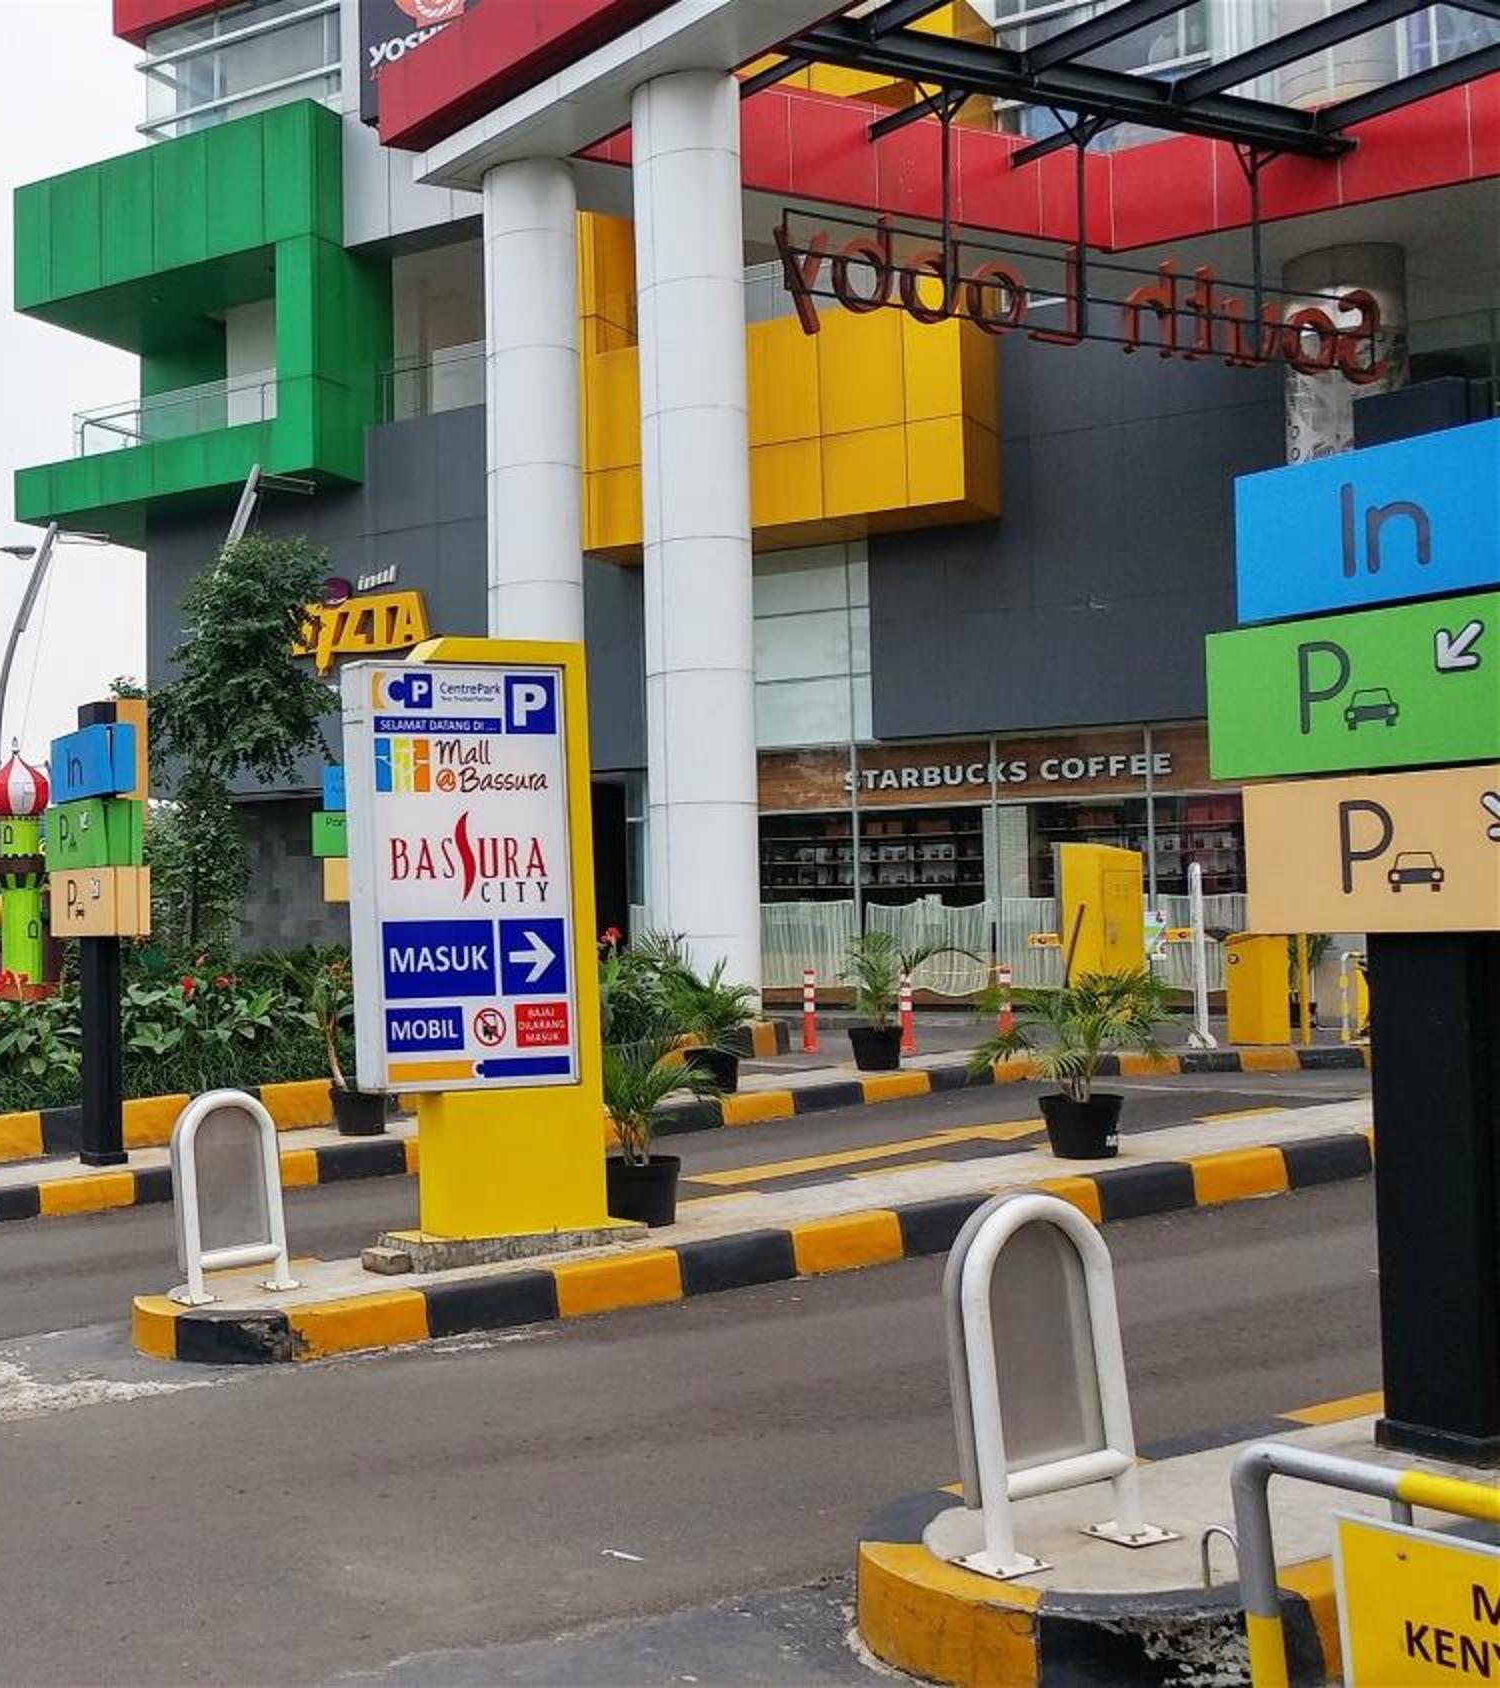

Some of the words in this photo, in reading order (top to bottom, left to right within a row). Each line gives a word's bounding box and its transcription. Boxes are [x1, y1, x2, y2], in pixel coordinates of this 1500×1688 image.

[1341, 483, 1431, 578] In
[357, 565, 397, 591] inul
[439, 681, 501, 695] CentrePark
[1298, 641, 1351, 735] P
[512, 684, 548, 727] P
[379, 719, 427, 731] SELAMAT
[429, 720, 470, 731] DATANG
[435, 739, 492, 765] Mall
[67, 751, 84, 789] In
[843, 761, 1028, 791] STARBUCKS
[1039, 753, 1173, 781] COFFEE
[389, 811, 549, 901] BASSURA
[1339, 800, 1394, 894] P
[480, 881, 549, 902] CITY
[388, 945, 489, 973] MASUK
[390, 1019, 460, 1041] MOBIL
